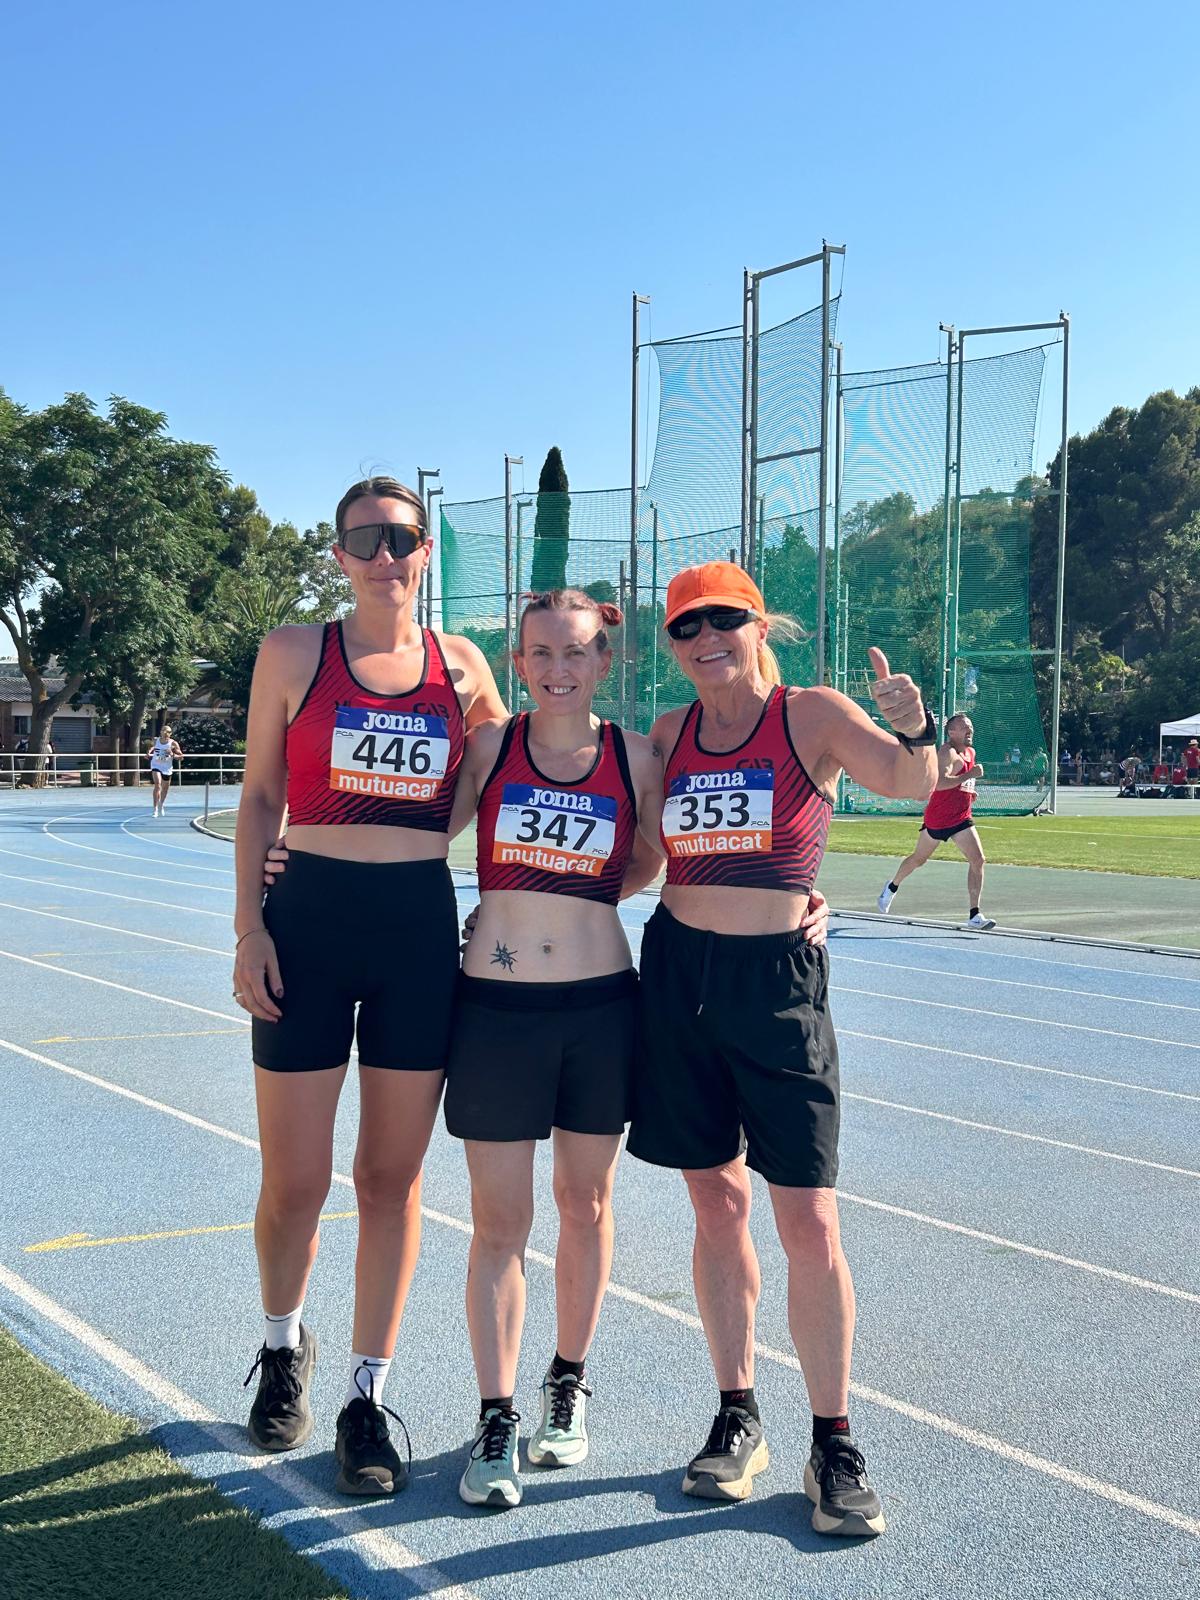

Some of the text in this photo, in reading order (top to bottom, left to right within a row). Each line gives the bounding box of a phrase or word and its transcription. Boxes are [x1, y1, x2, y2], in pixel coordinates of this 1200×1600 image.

[352, 734, 432, 775] 446
[338, 773, 438, 799] mutuacat
[679, 792, 750, 832] 353
[516, 808, 597, 851] 347
[672, 832, 763, 855] mutuacat
[501, 847, 597, 873] mutuacat
